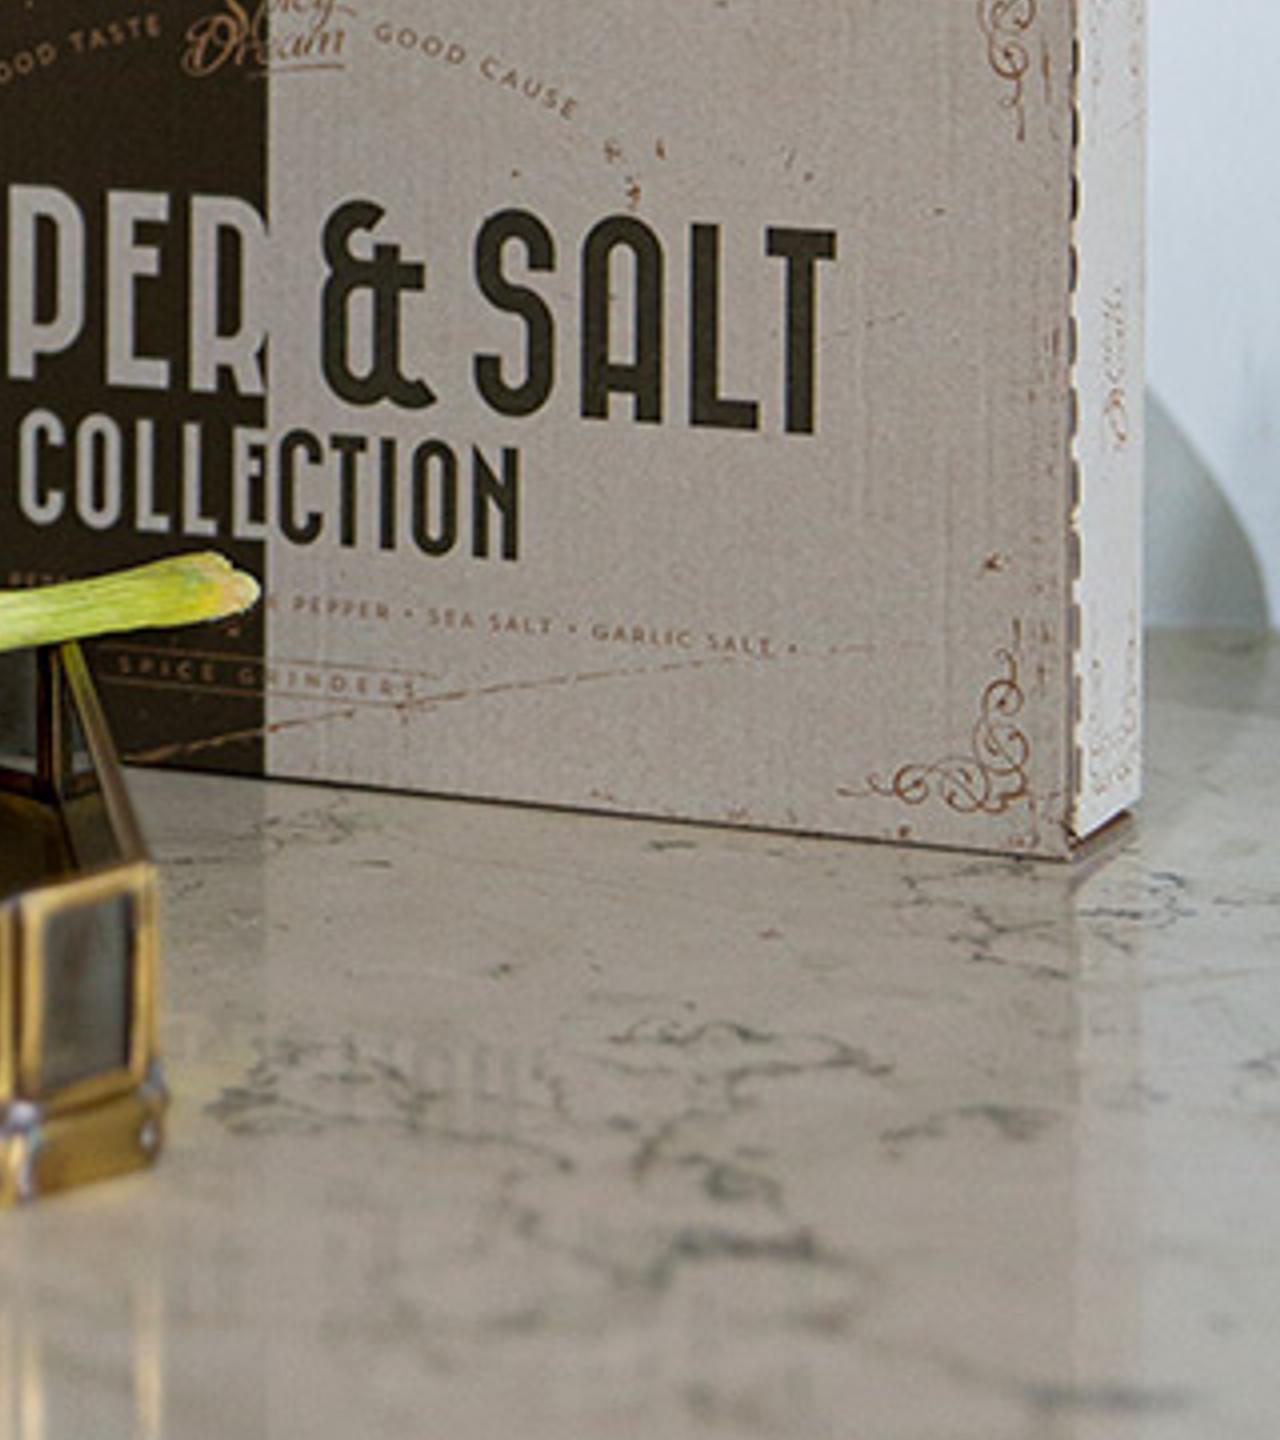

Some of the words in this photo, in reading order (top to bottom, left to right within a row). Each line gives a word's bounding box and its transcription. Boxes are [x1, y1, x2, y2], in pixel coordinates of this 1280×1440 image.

[69, 13, 161, 53] TASTE
[374, 22, 466, 66] GOOD
[479, 53, 578, 121] CAUSE
[321, 199, 437, 410] &
[474, 207, 836, 436] SALT
[18, 408, 520, 561] COLLECTION
[294, 596, 389, 620] PEPPER
[428, 608, 474, 629] SEA
[489, 613, 552, 635] SALT
[592, 623, 692, 650] GARLIC
[707, 633, 771, 656] SALT
[119, 654, 217, 682] SPICE
